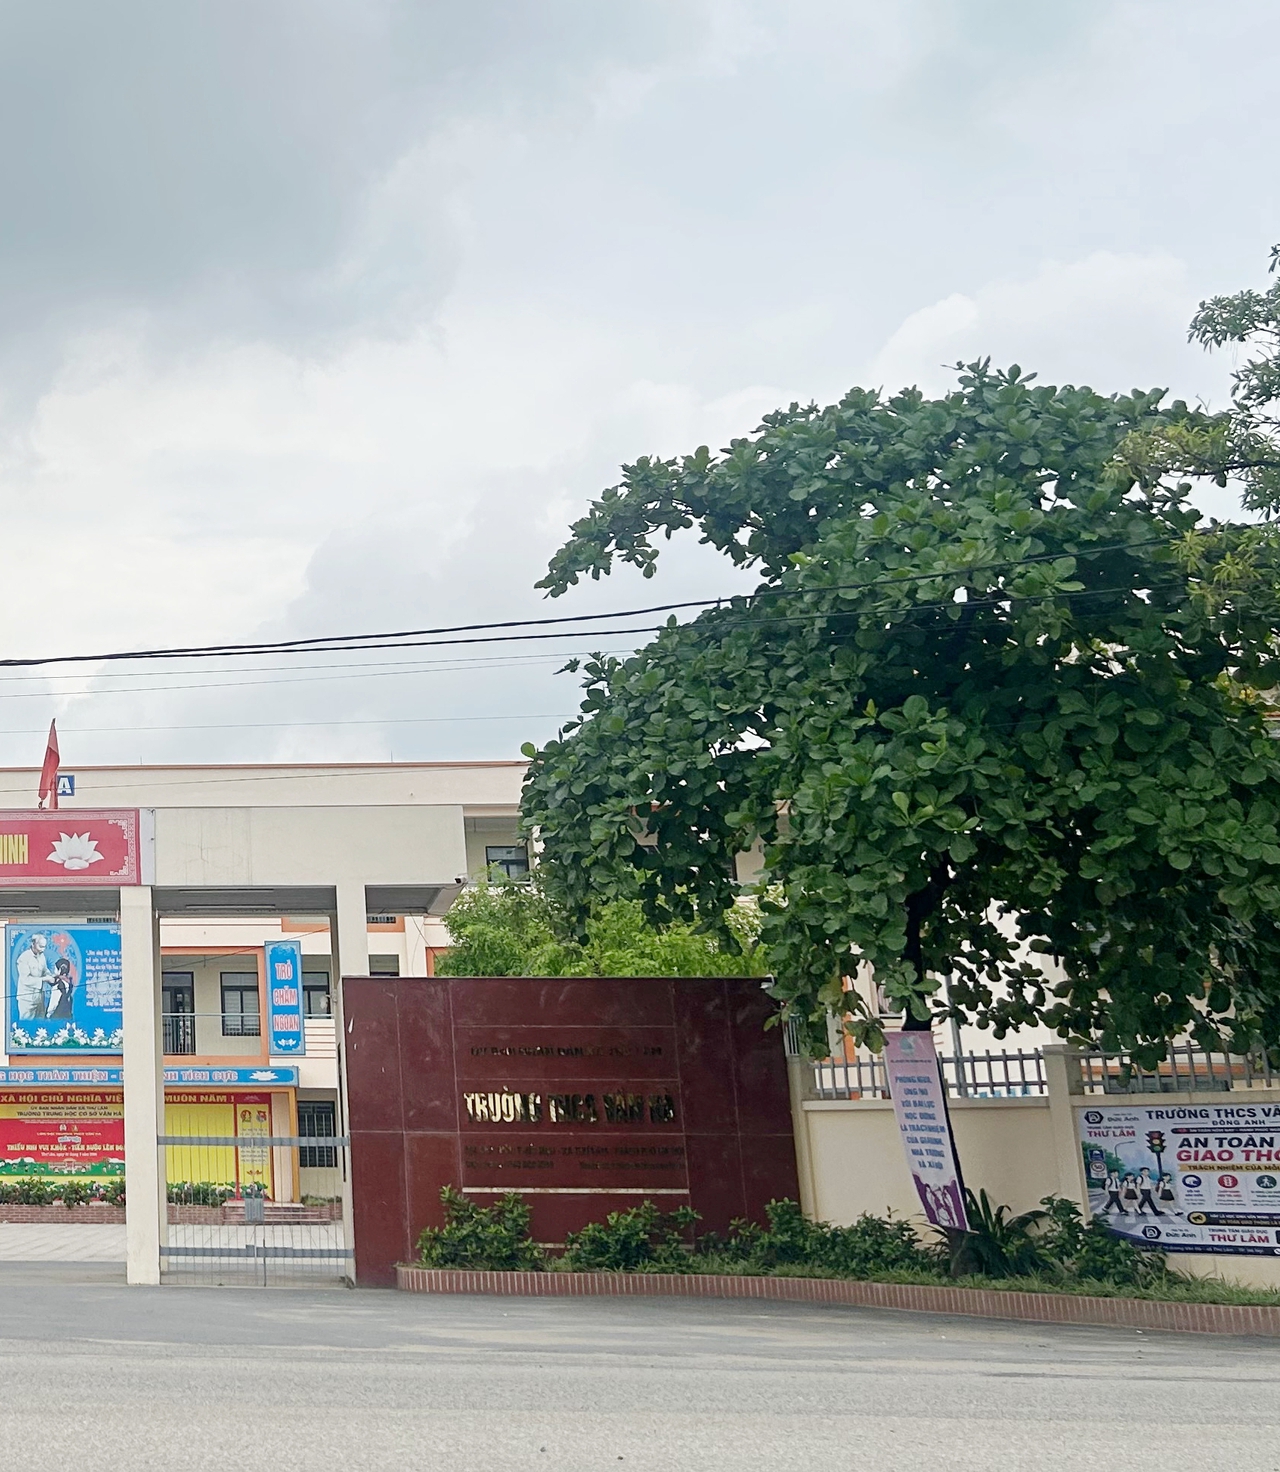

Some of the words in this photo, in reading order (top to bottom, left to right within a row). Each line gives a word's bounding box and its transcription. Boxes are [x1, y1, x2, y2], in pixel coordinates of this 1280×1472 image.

[57, 777, 72, 794] A
[273, 985, 298, 1006] CHĂM
[273, 1014, 300, 1032] NGOAN
[8, 1070, 34, 1083] HỌC
[36, 1069, 69, 1081] THÂN
[71, 1069, 108, 1083] THIỆN
[181, 1069, 210, 1081] TÍCH
[212, 1070, 239, 1083] CỰC
[19, 1094, 38, 1104] HỘI
[41, 1092, 64, 1103] CHỦ
[67, 1093, 103, 1103] NGHĨA
[105, 1093, 124, 1103] VIỆ
[164, 1094, 197, 1103] MUÔN
[199, 1094, 227, 1103] NĂM
[463, 1085, 542, 1122] TRƯỜNG
[1145, 1106, 1210, 1119] TRƯỜNG
[1214, 1107, 1257, 1118] THCS
[1113, 1129, 1136, 1137] LÂM
[1178, 1137, 1209, 1148] AN
[1214, 1134, 1275, 1148] TOÀN
[1176, 1149, 1234, 1161] GIAO
[1187, 1163, 1215, 1171] TRÁCH
[1209, 1233, 1237, 1243] THƯ
[1241, 1234, 1270, 1243] LÂM
